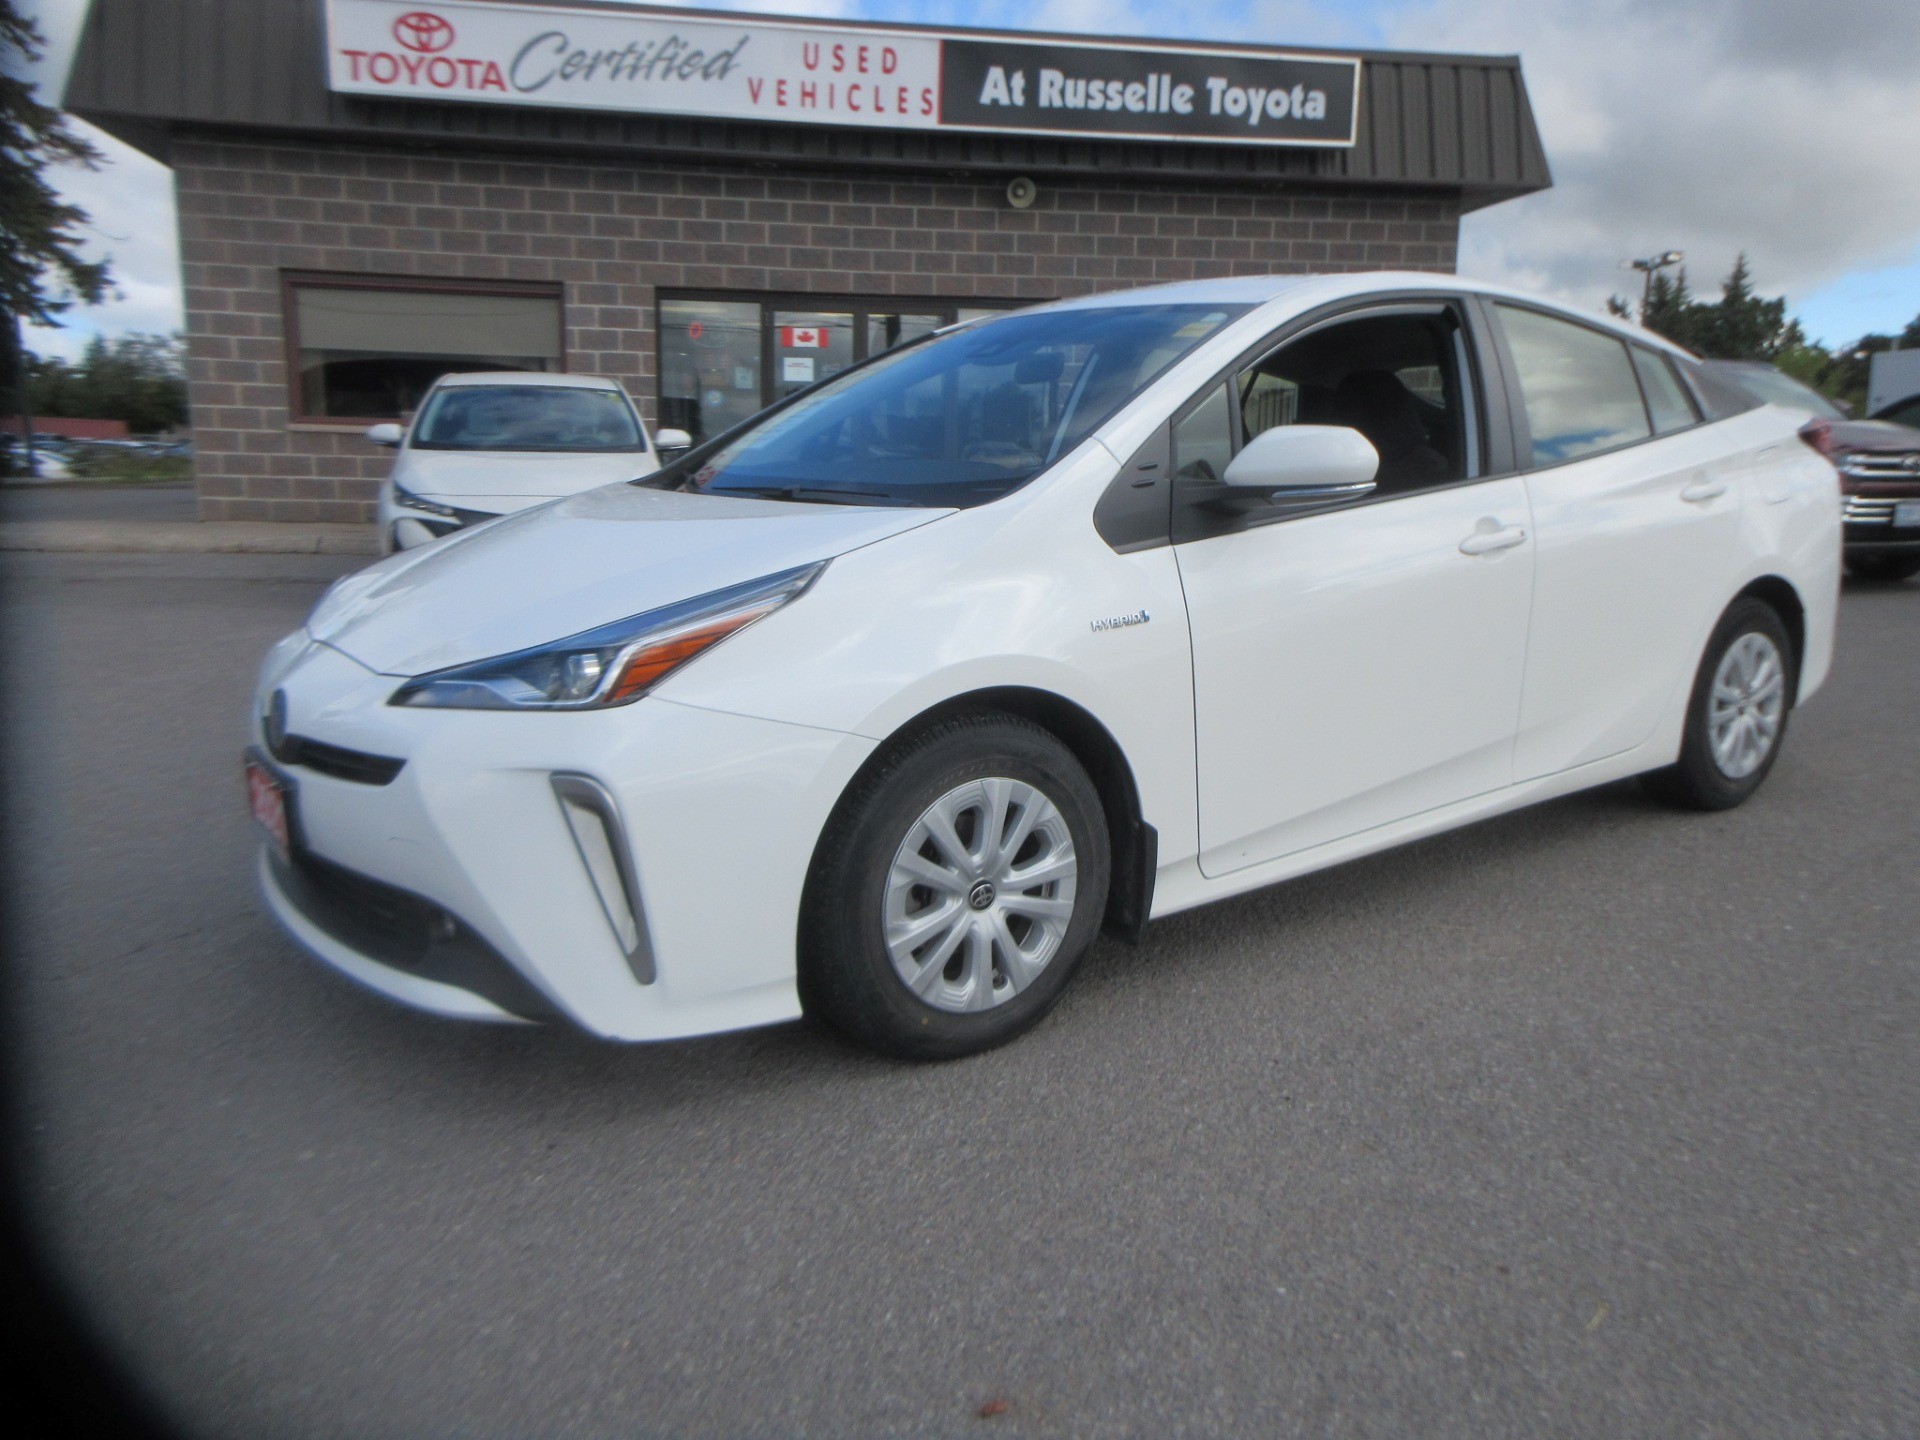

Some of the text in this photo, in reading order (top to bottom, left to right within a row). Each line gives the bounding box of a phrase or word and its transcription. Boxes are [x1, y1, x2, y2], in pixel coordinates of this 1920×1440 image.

[340, 31, 750, 93] TOYOTA Certified
[802, 42, 898, 75] USED
[747, 76, 935, 116] VEHICLES
[979, 66, 1327, 125] At Russelle Toyota
[1091, 613, 1142, 632] HYBRID
